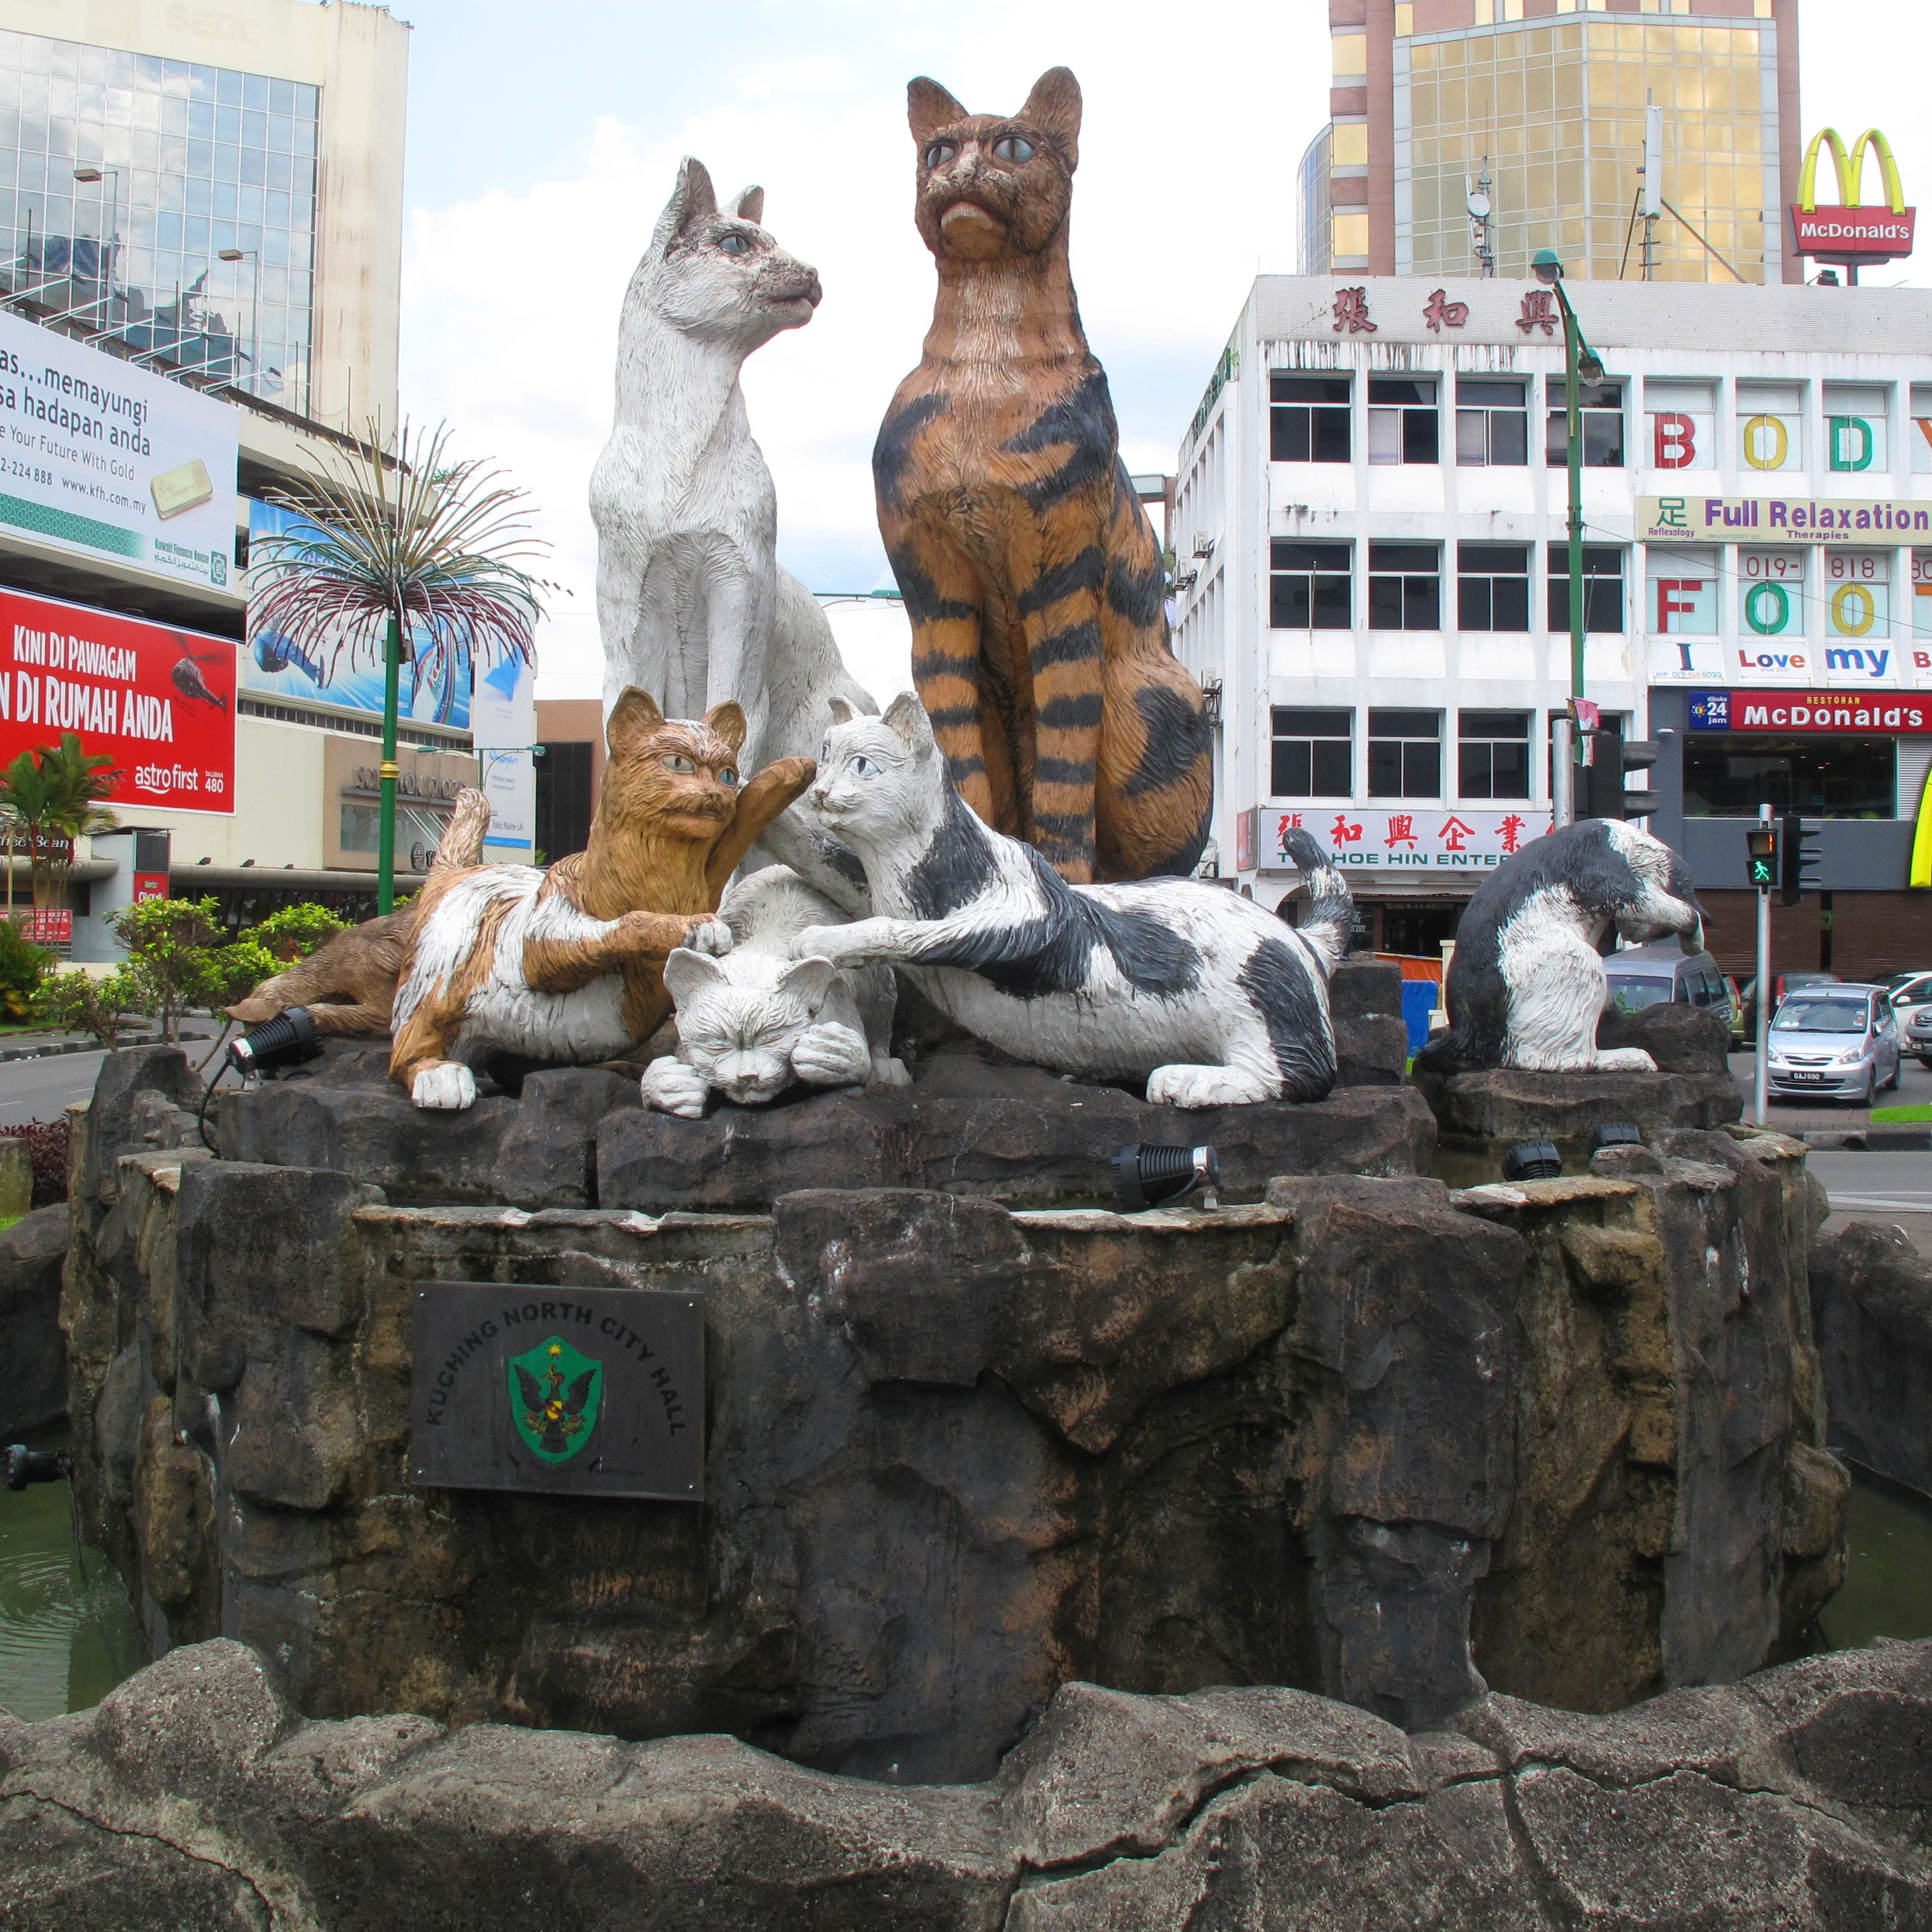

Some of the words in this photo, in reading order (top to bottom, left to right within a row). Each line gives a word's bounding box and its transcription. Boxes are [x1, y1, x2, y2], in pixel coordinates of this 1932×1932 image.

[1800, 223, 1909, 239] McDonald's
[1332, 286, 1559, 335] 張和興
[24, 386, 103, 441] hadapan
[110, 425, 150, 457] anda
[10, 424, 36, 449] Your
[40, 435, 78, 463] Future
[82, 449, 107, 473] With
[110, 459, 135, 481] Gold
[34, 468, 53, 486] 888
[62, 478, 147, 516] www.kfh.com.my
[1656, 498, 1687, 527] 足
[1705, 499, 1759, 527] Full
[1769, 501, 1929, 530] Relaxation
[1648, 527, 1695, 538] Reflexology
[1786, 530, 1850, 541] Therapies
[154, 538, 173, 554] Kuwait
[173, 543, 193, 560] Finance
[194, 549, 209, 564] House
[1831, 558, 1875, 579] 818
[13, 624, 46, 666] KINI
[50, 631, 64, 670] DI
[68, 635, 137, 683] PAWAGAM
[1676, 643, 1695, 671] I
[1738, 649, 1806, 669] Love
[1825, 648, 1889, 677] my
[17, 671, 39, 724] DI
[45, 675, 117, 735] RUMAH
[122, 689, 173, 743] ANDA
[1707, 702, 1728, 716] 24
[1806, 697, 1861, 705] RESTORAN
[1707, 717, 1727, 726] jam
[1743, 705, 1923, 727] McDonald's
[135, 763, 171, 787] astro
[173, 764, 199, 791] first
[205, 778, 224, 794] 480
[492, 819, 503, 830] Tokio
[503, 821, 516, 831] Marine
[1331, 852, 1379, 865] HOE
[1388, 853, 1428, 865] HIN
[425, 1320, 498, 1426] KUCHING
[502, 1301, 593, 1328] NORTH
[600, 1317, 655, 1362] CITY
[650, 1366, 686, 1437] HALL
